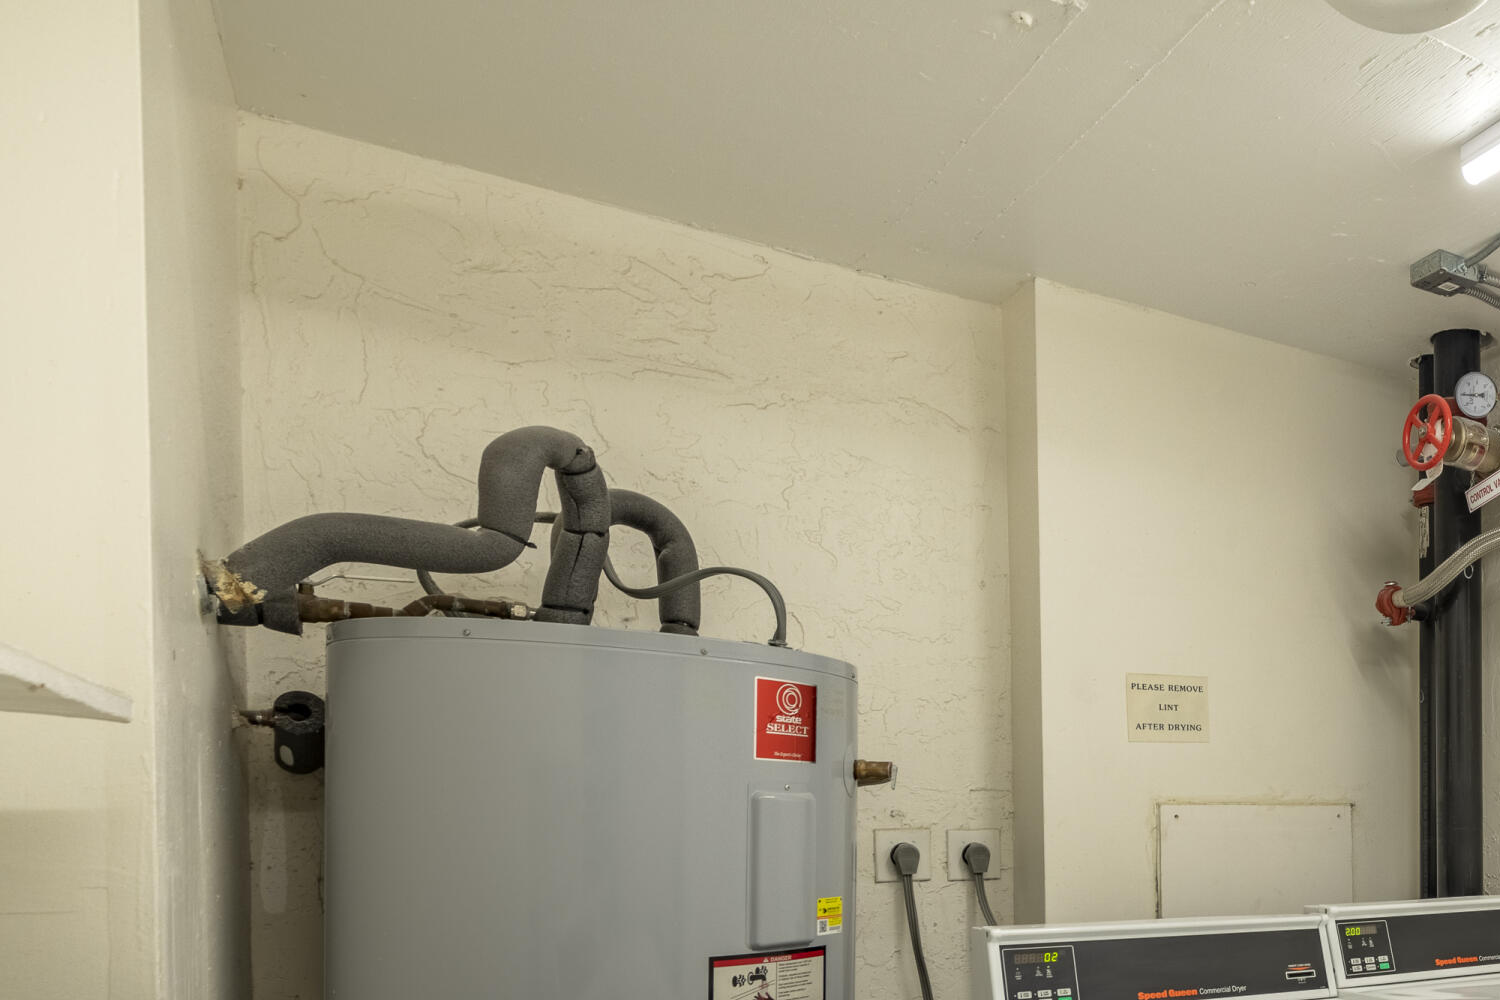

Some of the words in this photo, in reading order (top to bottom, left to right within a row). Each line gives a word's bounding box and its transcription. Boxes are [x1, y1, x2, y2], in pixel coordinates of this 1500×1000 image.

[1469, 484, 1494, 504] CONTROL
[1131, 682, 1165, 691] PLEASE
[1168, 684, 1204, 693] REMOVE
[1158, 703, 1179, 712] LINT
[776, 715, 802, 725] state
[766, 722, 809, 735] SELECT
[1135, 722, 1165, 731] AFTER
[1168, 723, 1202, 732] DRYING
[1044, 952, 1058, 962] 02
[1168, 988, 1198, 998] Queen
[1199, 986, 1231, 995] Commercial
[1231, 985, 1247, 993] Dryer
